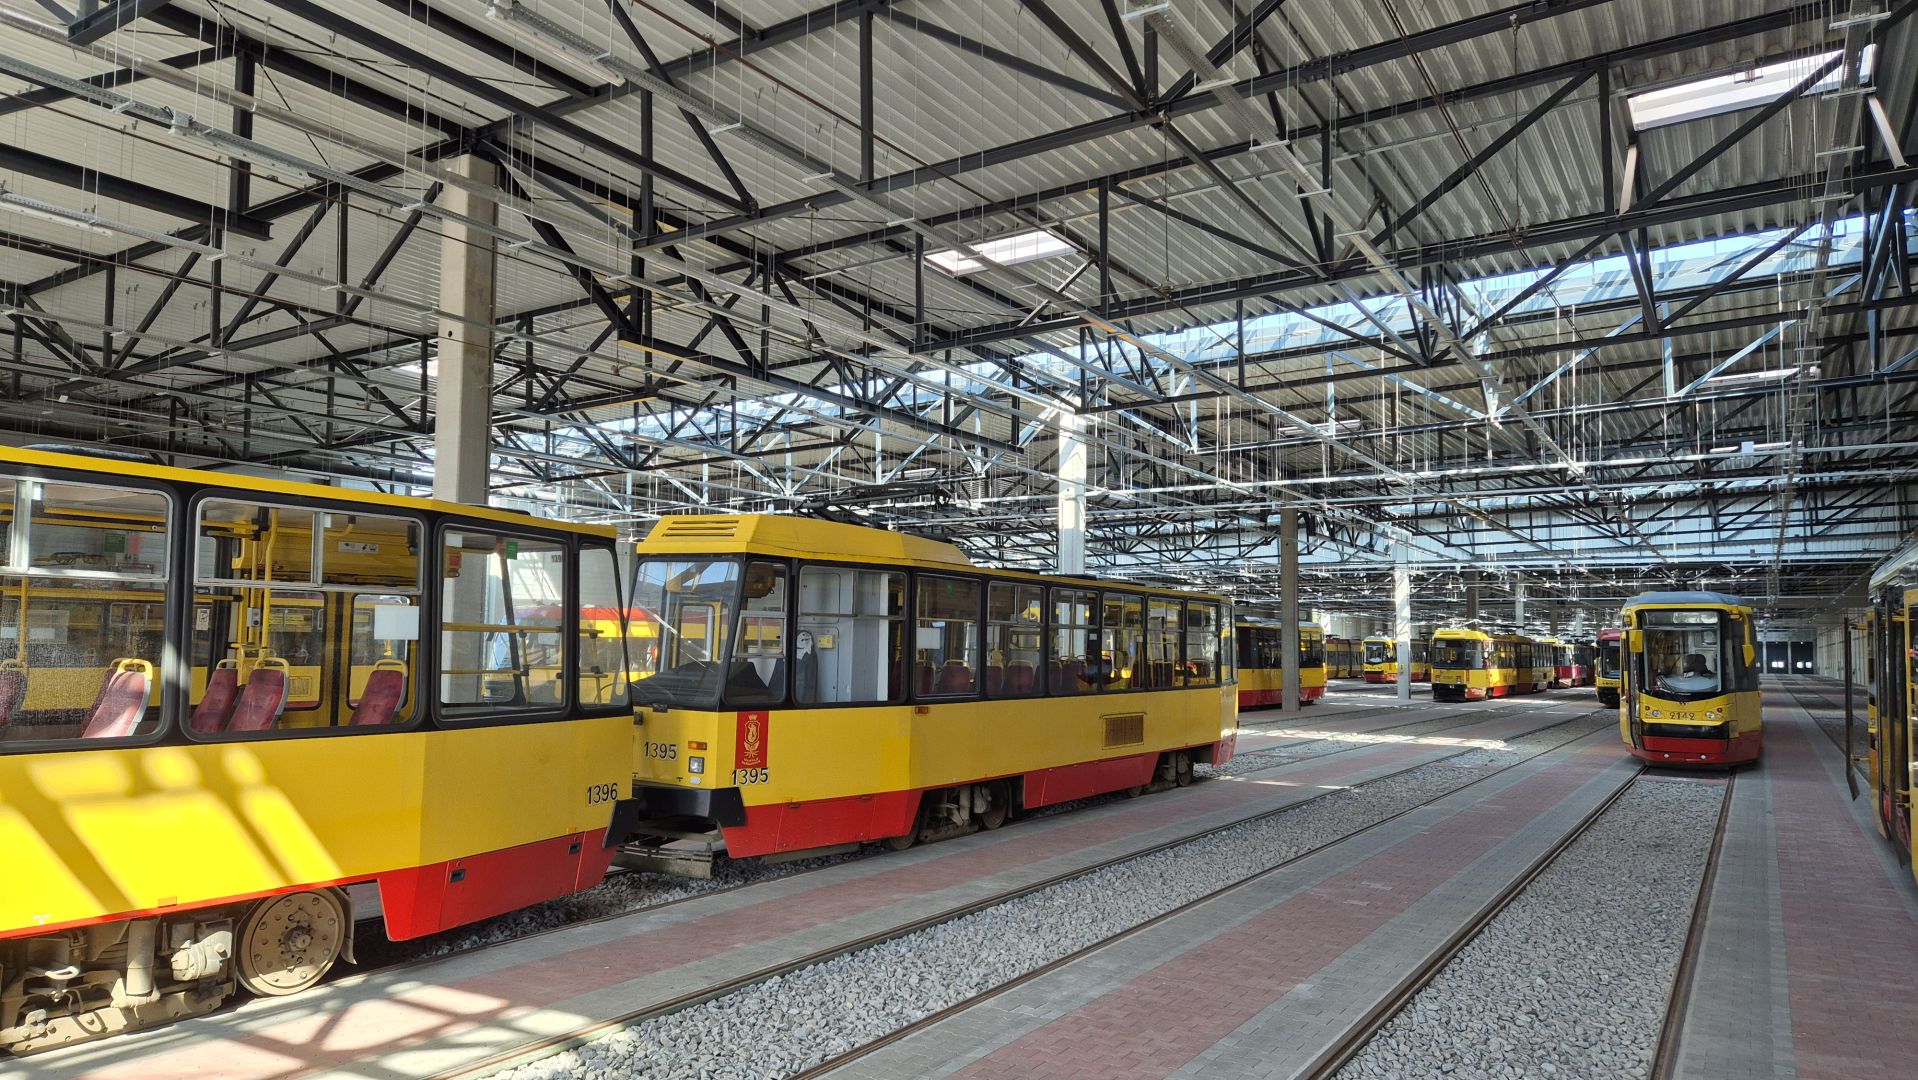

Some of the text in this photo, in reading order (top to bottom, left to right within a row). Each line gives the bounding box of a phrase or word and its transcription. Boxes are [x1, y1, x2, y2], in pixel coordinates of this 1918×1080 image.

[1669, 712, 1695, 720] 2142
[643, 741, 677, 760] 1395
[731, 767, 769, 785] 1395
[587, 783, 618, 804] 1396
